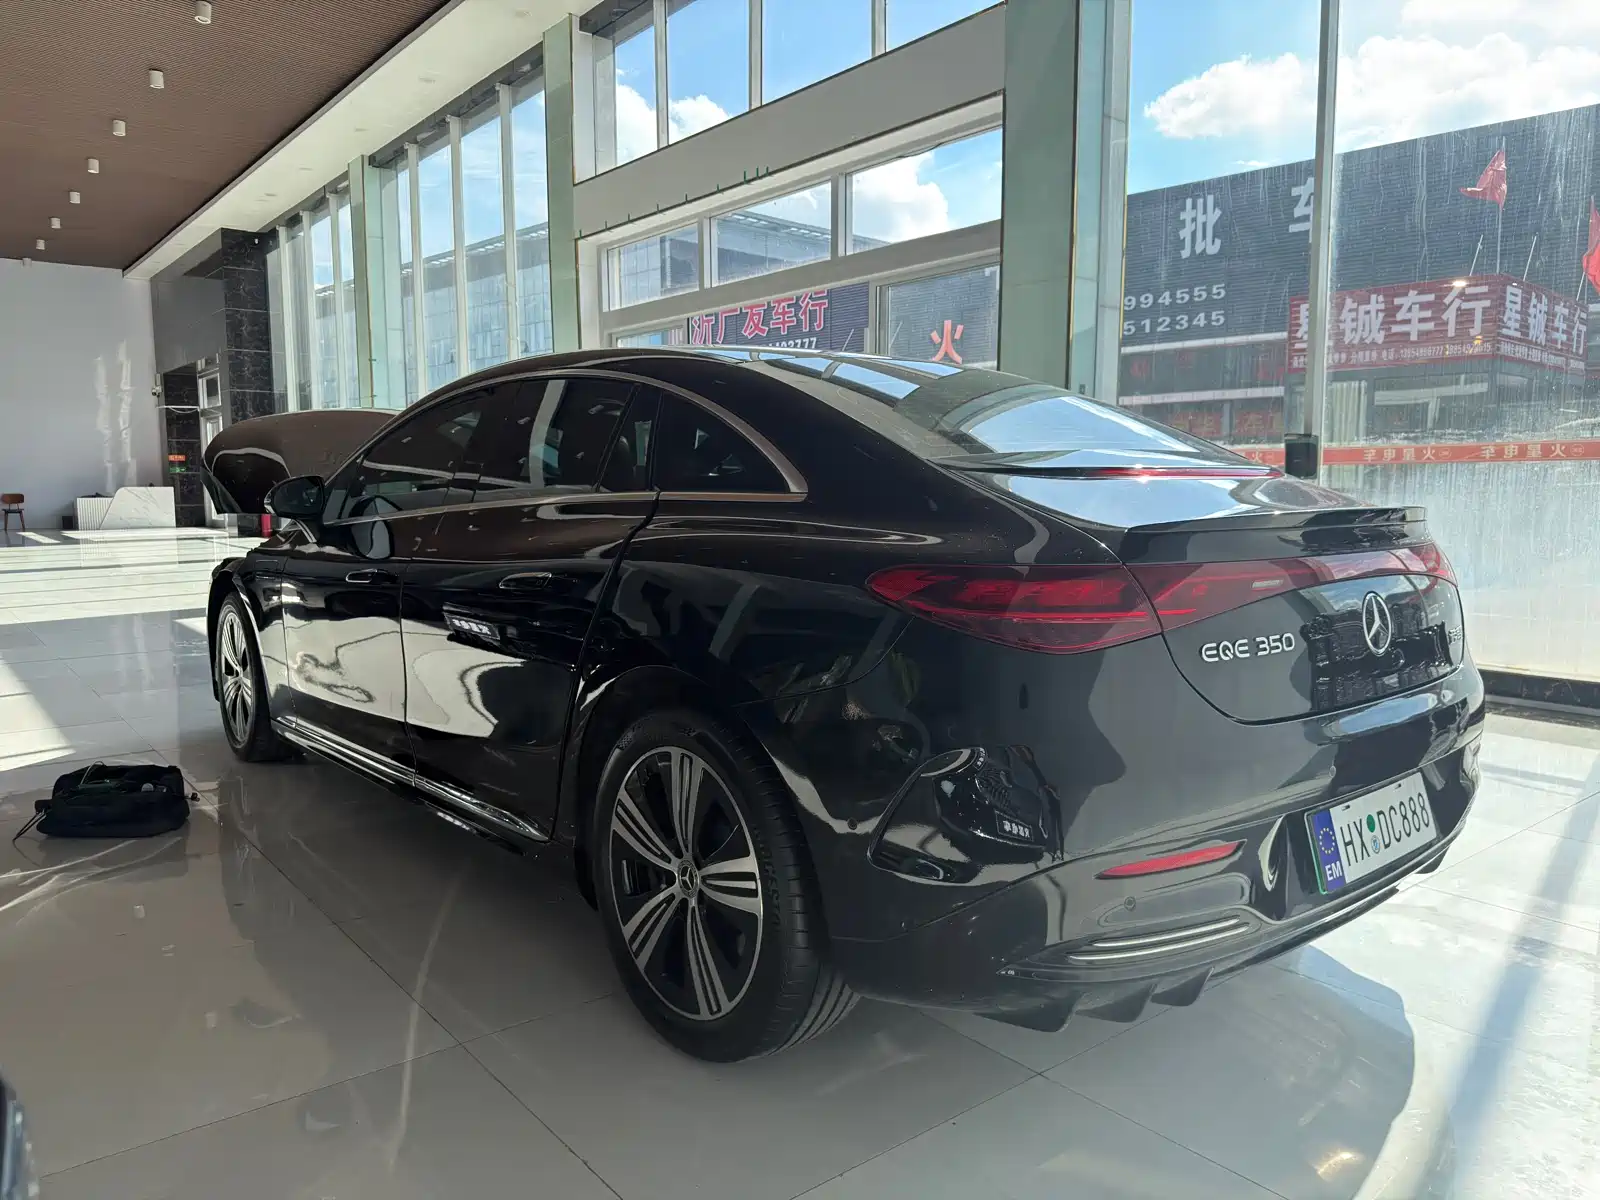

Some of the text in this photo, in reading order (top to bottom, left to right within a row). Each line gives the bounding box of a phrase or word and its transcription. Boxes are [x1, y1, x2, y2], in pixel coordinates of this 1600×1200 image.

[930, 320, 964, 364] 火
[1201, 632, 1295, 663] EQE 350
[1341, 792, 1430, 867] HX DC888
[1325, 861, 1342, 882] EM
